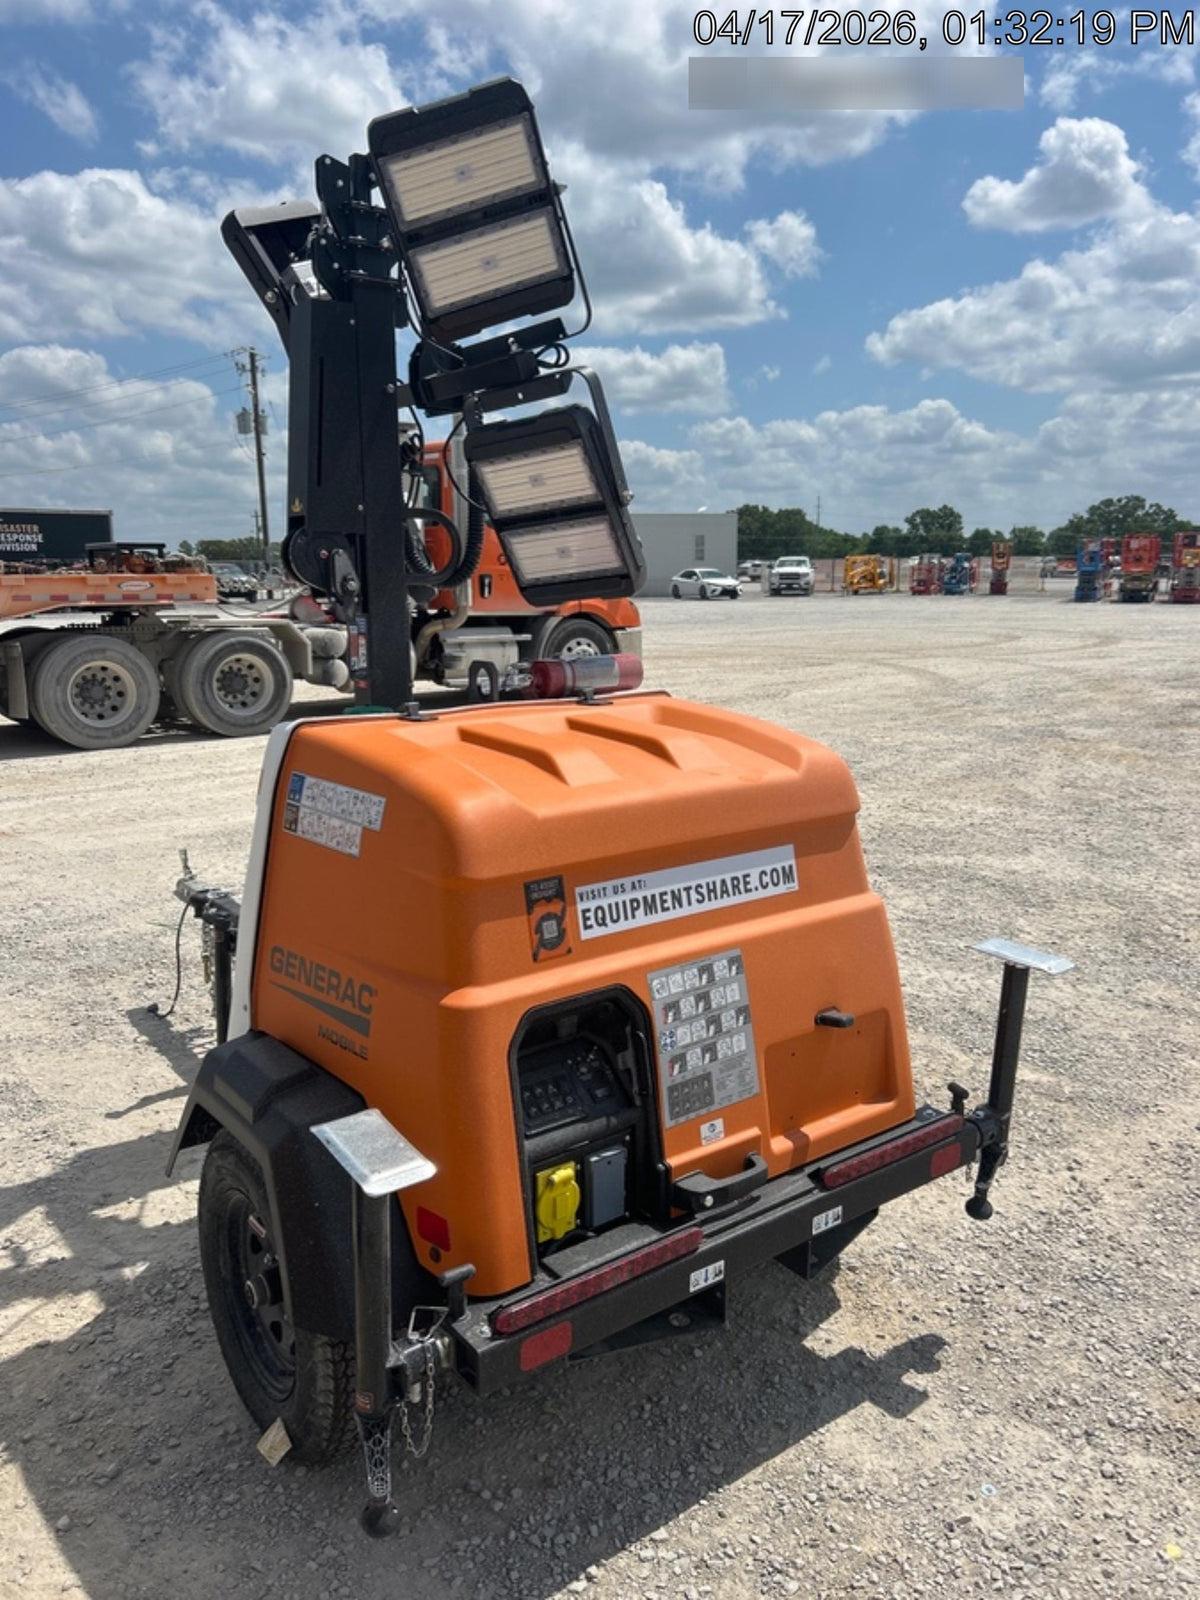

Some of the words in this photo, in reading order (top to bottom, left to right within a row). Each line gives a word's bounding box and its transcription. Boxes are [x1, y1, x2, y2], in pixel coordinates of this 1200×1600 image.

[0, 523, 39, 533] ISASTER
[0, 533, 44, 543] ESPONSE
[0, 543, 38, 552] IVISION
[578, 886, 607, 902] VISIT
[613, 883, 626, 895] US
[631, 879, 647, 892] AT:
[581, 863, 796, 931] EQUIPMENTSHARE.COM
[269, 945, 375, 1016] GENERAC
[317, 1023, 369, 1062] MOBILE
